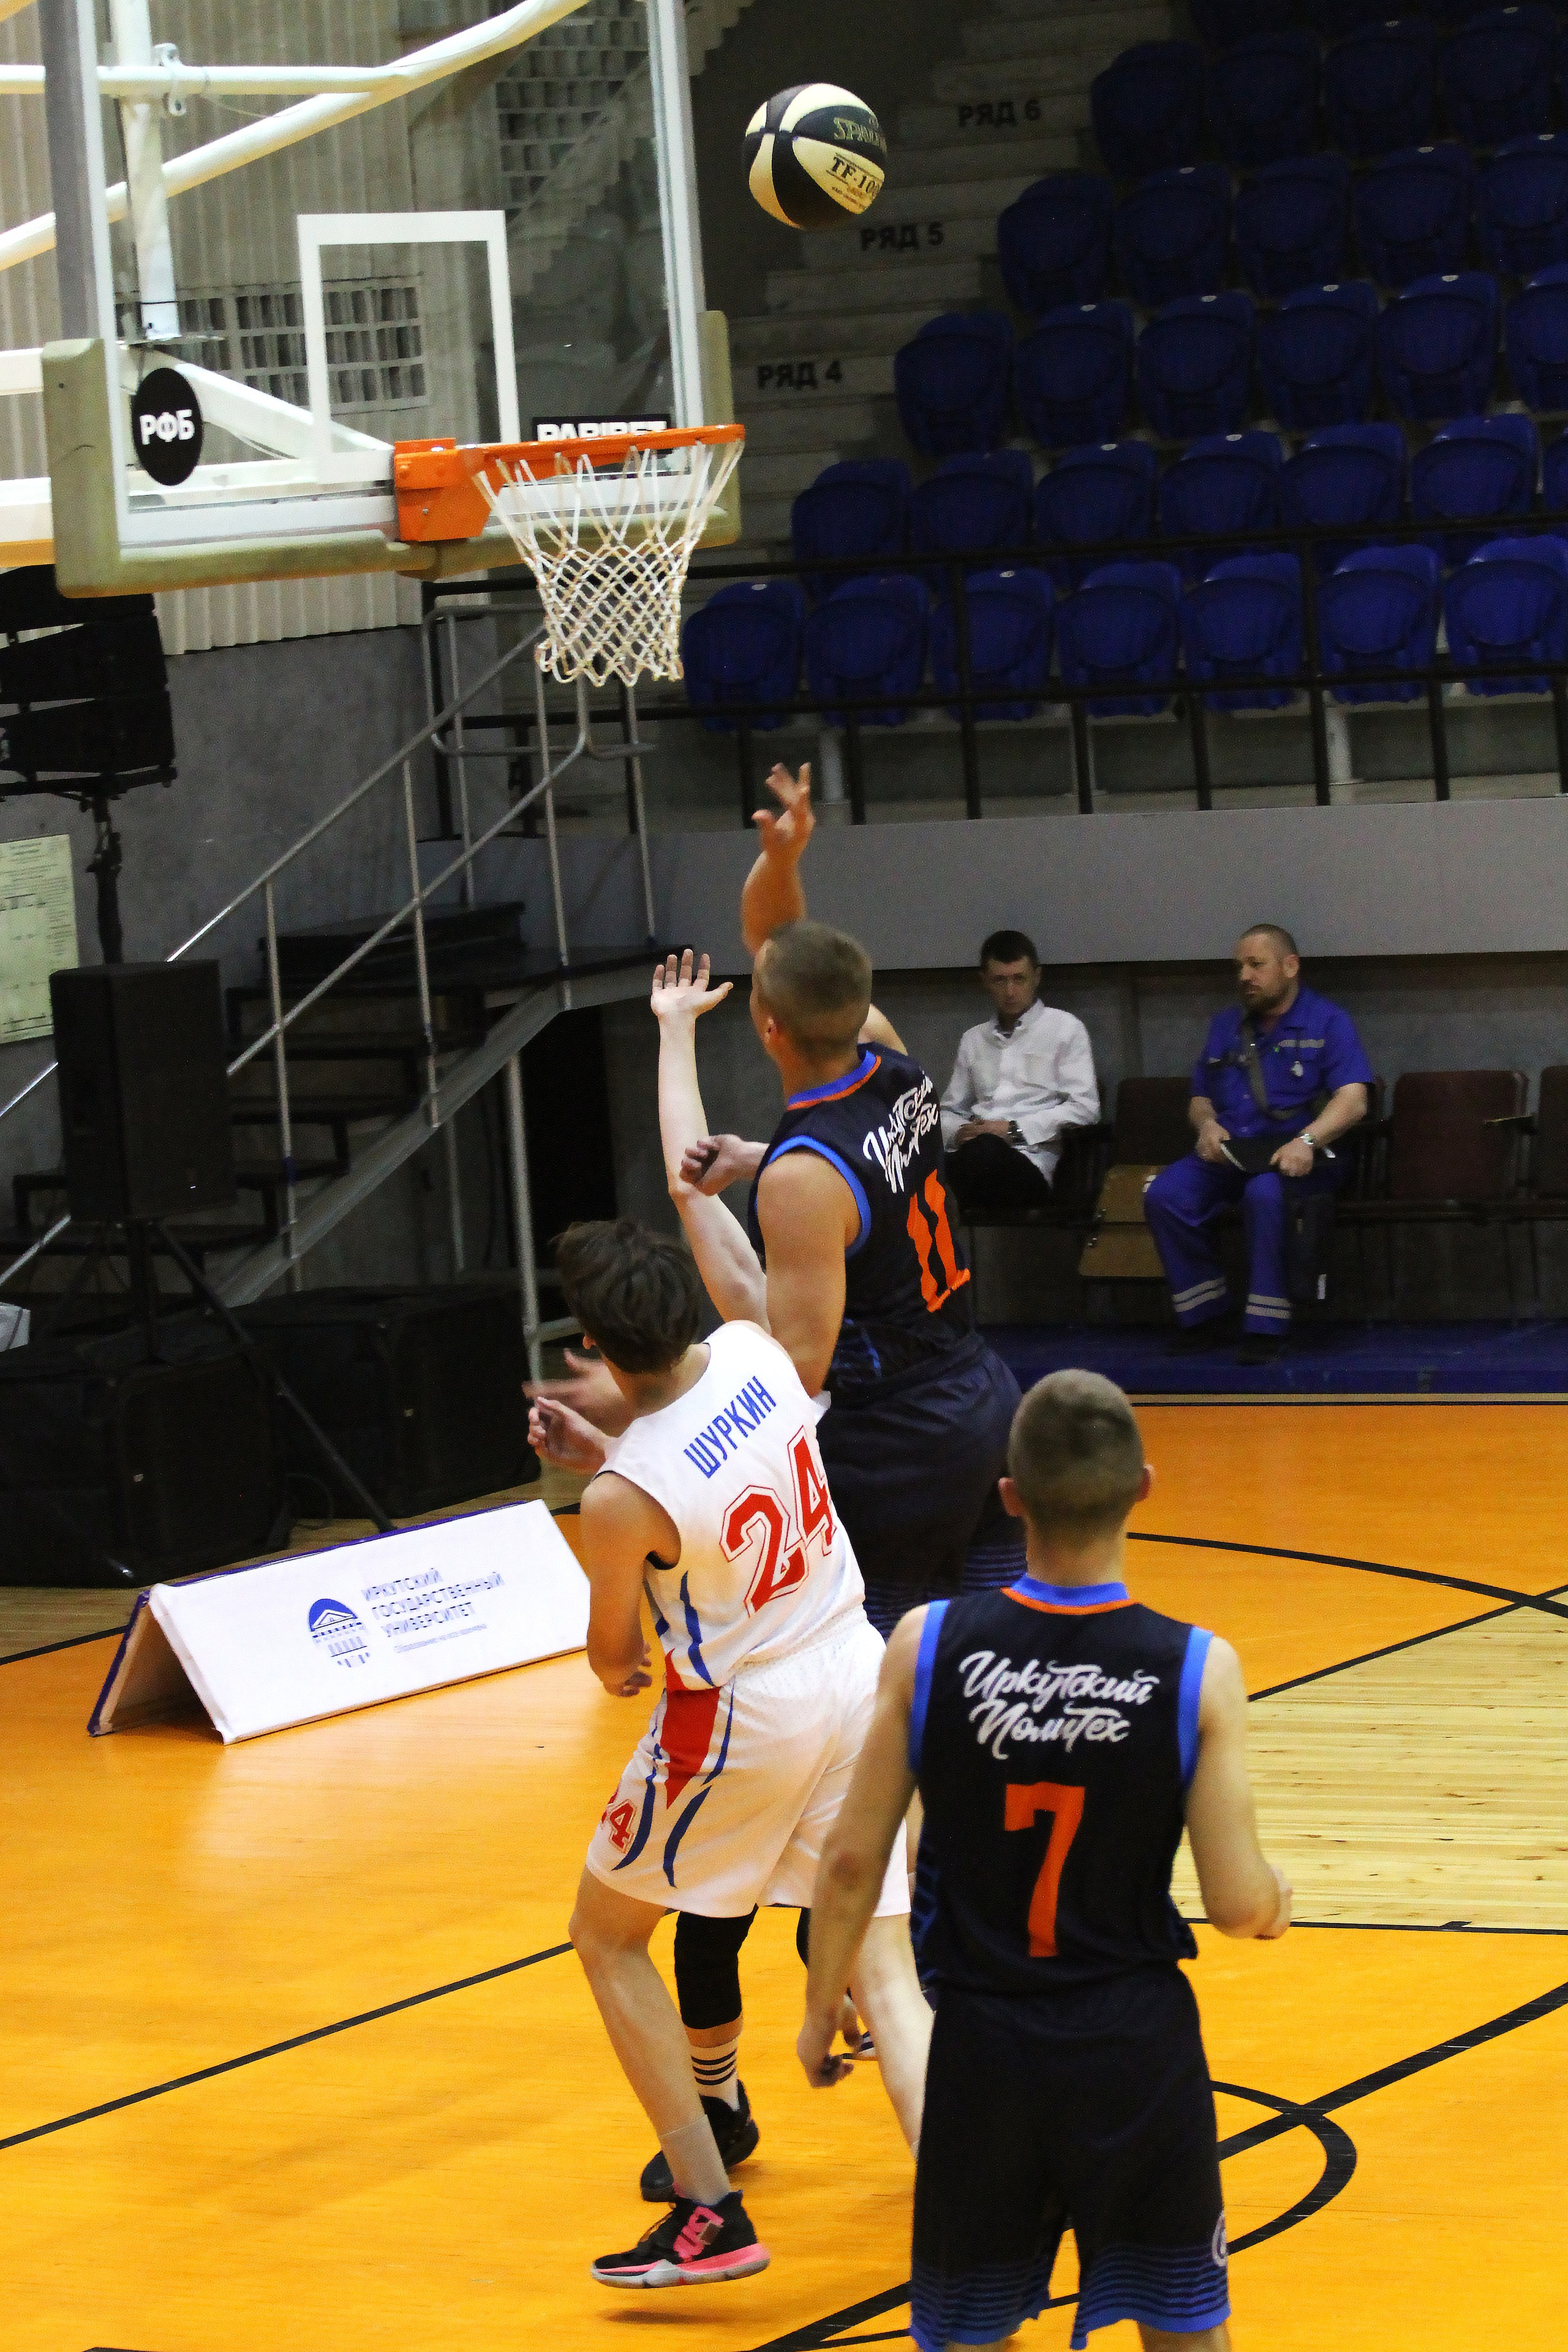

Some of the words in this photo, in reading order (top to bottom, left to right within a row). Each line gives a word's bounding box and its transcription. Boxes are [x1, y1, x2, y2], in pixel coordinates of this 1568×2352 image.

[959, 101, 1017, 127] РЯД
[1025, 98, 1041, 121] 6
[861, 224, 920, 251] РЯД
[928, 221, 944, 246] 5
[758, 361, 817, 390] РЯД
[826, 360, 842, 383] 4
[140, 409, 195, 445] РФБ
[907, 1168, 971, 1313] 11
[683, 1376, 777, 1479] ШУРКИН
[719, 1425, 837, 1618] 24
[361, 1567, 443, 1602] ИРКУТСКИЙ
[372, 1571, 505, 1620] ГОСУДАРСТВЕННЫЙ
[380, 1602, 477, 1638] УНИВЕРСИТЕТ
[1004, 1781, 1085, 1957] 7
